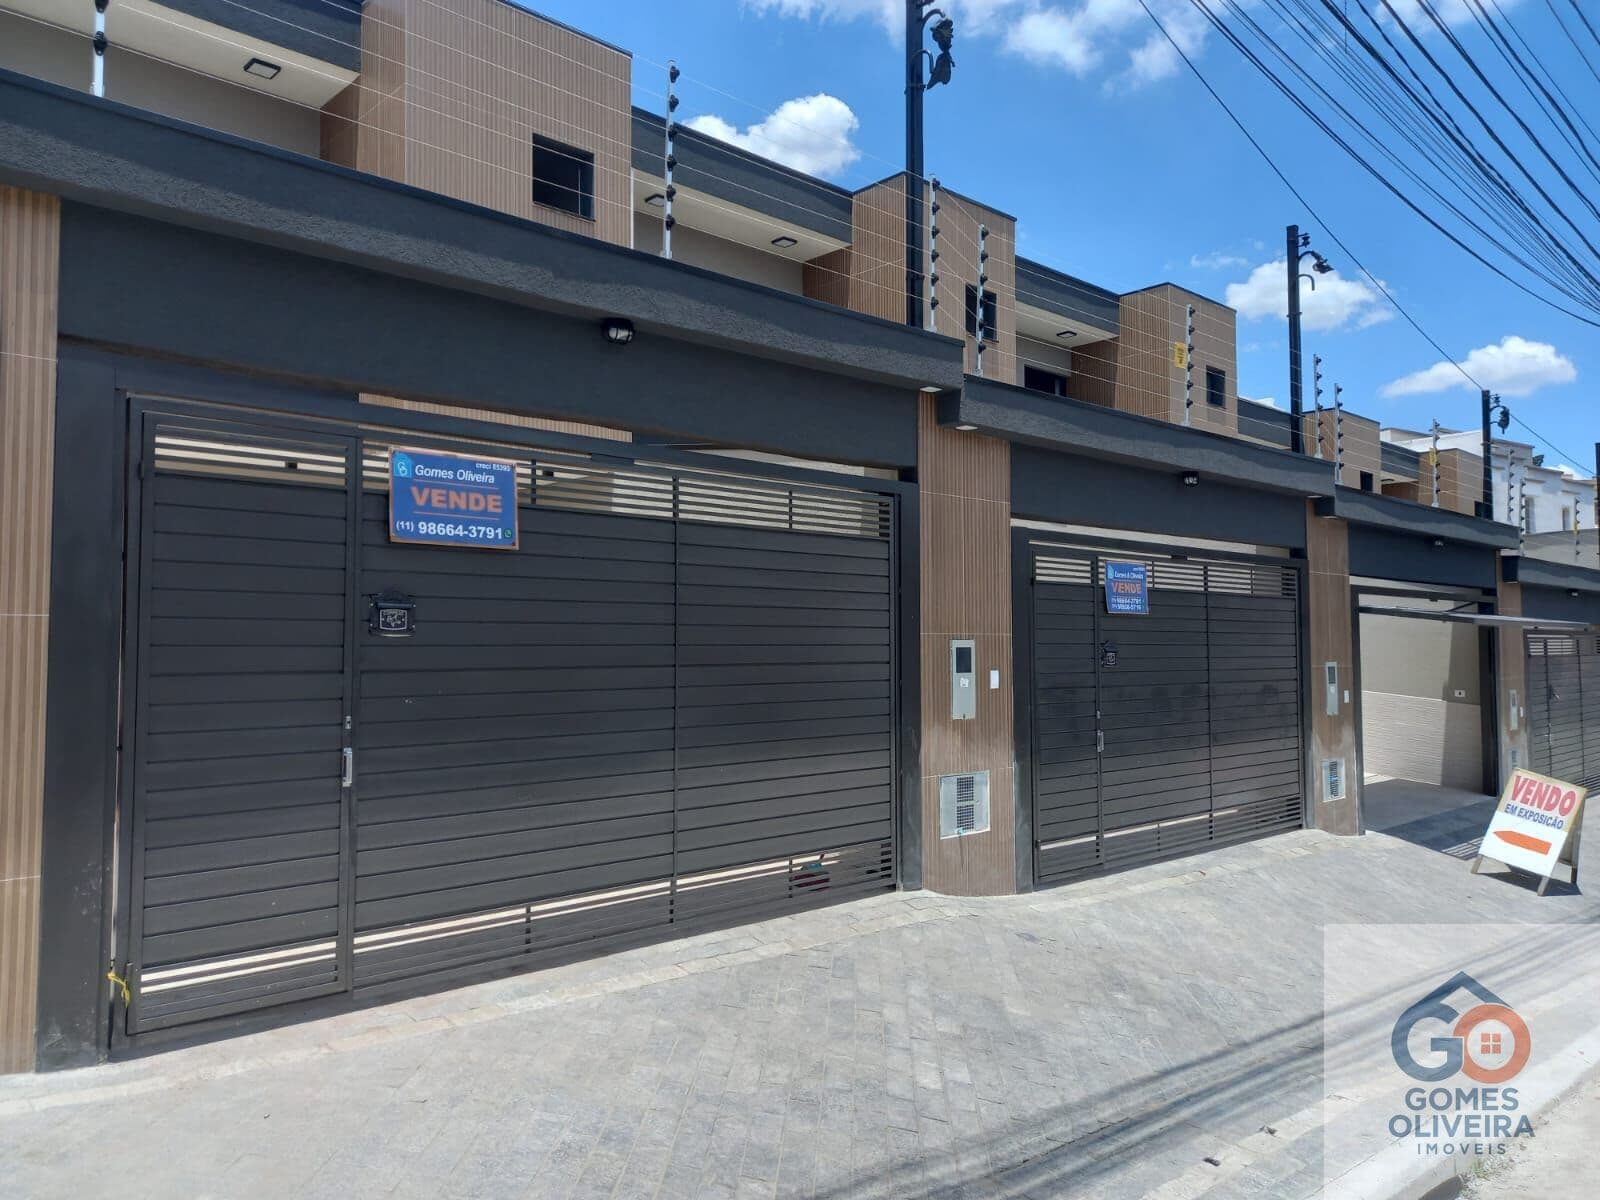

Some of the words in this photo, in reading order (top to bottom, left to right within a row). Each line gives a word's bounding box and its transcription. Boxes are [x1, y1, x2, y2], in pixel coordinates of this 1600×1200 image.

[415, 464, 454, 480] Gomes
[456, 469, 495, 484] Oliveira
[410, 486, 503, 513] VENDE
[396, 521, 415, 532] (11)
[418, 522, 503, 540] 98664-3791
[1112, 581, 1143, 594] VENDE
[1511, 775, 1576, 817] VENDO
[1503, 803, 1518, 817] EM
